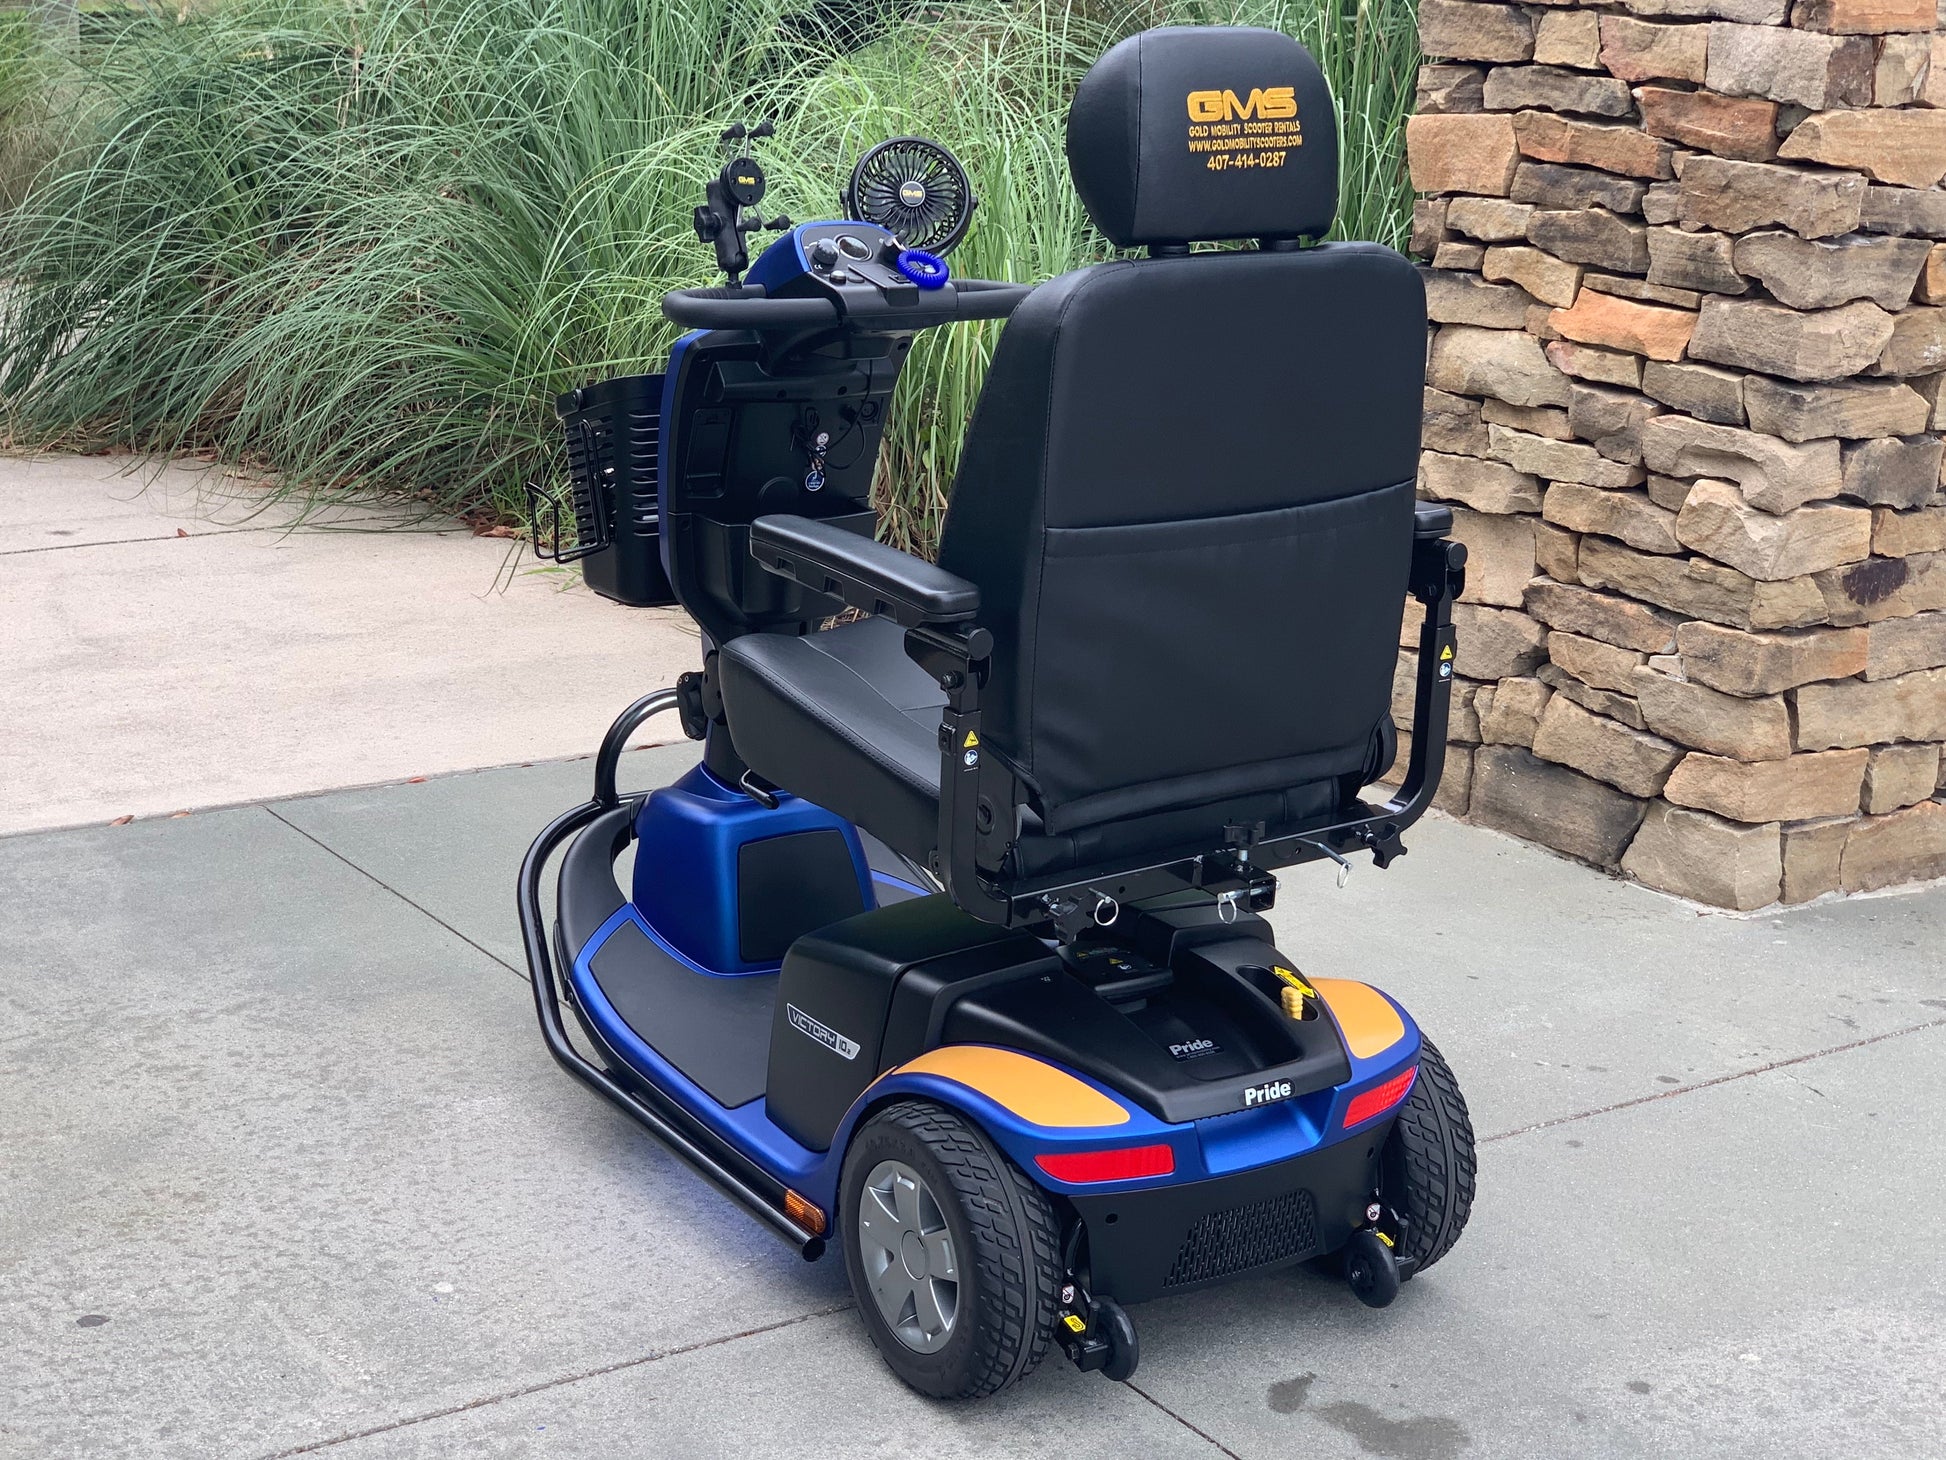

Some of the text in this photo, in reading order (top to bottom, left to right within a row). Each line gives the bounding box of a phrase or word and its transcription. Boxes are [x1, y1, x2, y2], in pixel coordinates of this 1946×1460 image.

[1187, 87, 1298, 122] GMS
[1189, 120, 1301, 137] GOLD MOBILITY SCOOTER RENTALS
[1188, 134, 1303, 152] WWW.GOLDMOBILITYSCOOTERS.COM
[1207, 151, 1287, 171] 407-414-0287
[792, 1010, 836, 1045] VICTORY
[1169, 1039, 1214, 1056] Pride
[1244, 1081, 1291, 1106] Pride
